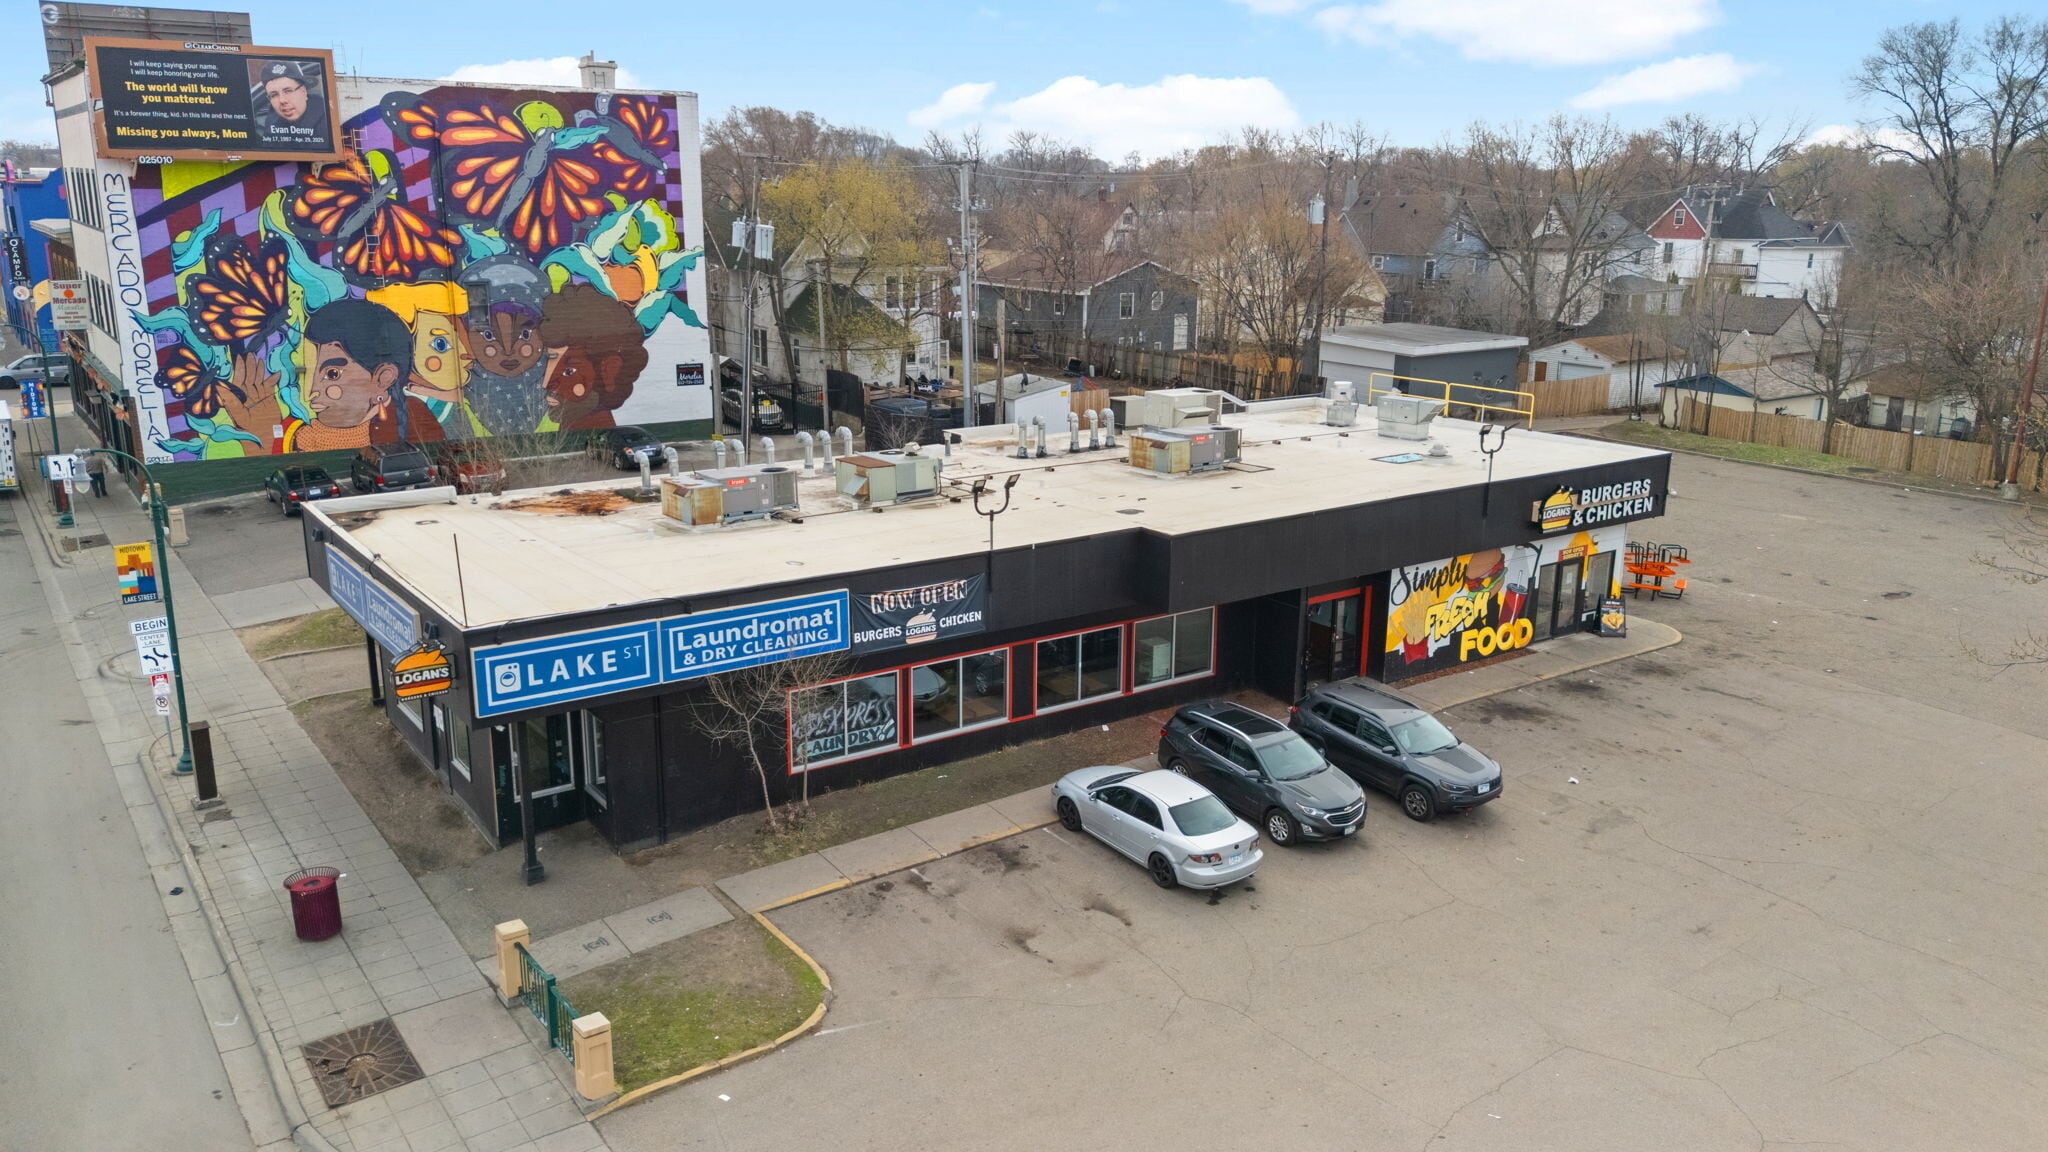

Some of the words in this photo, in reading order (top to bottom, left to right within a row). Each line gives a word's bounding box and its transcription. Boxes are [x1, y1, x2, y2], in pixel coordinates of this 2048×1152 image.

[146, 61, 162, 69] keep
[163, 62, 183, 70] saying
[147, 69, 162, 77] keep
[163, 70, 192, 78] honoring
[125, 81, 145, 91] The
[147, 83, 177, 93] world
[179, 83, 198, 93] will
[200, 84, 228, 94] know
[142, 95, 161, 104] you
[164, 94, 215, 104] mattered.
[116, 126, 159, 138] Missing
[160, 129, 179, 138] you
[181, 128, 220, 139] always,
[222, 129, 248, 138] Mom
[270, 125, 288, 134] Evan
[290, 125, 314, 136] Denny
[139, 155, 173, 164] 025010
[103, 173, 142, 307] MERCADO
[10, 239, 22, 277] OCAMPO
[132, 329, 164, 440] MORELIA
[1581, 478, 1651, 506] BURGERS
[1542, 505, 1571, 521] LOGAN'S
[1572, 510, 1583, 527] &
[1585, 496, 1653, 524] CHICKEN
[119, 544, 146, 553] MIDTOWN
[336, 570, 357, 603] LAKE
[1391, 557, 1469, 606] Simply
[123, 595, 138, 603] LAKE
[138, 592, 157, 602] STREET
[870, 589, 915, 614] NOW
[919, 579, 968, 604] OPEN
[367, 590, 412, 641] Laundromat
[939, 610, 982, 628] CHICKEN
[1424, 592, 1490, 641] FRESH
[135, 618, 167, 632] BEGIN
[677, 608, 834, 651] Laundromat
[905, 624, 937, 637] LOGAN'S
[140, 633, 165, 641] CENTER
[853, 626, 902, 643] BURGERS
[1460, 618, 1533, 662] FOOD
[683, 652, 697, 666] &
[702, 644, 738, 663] DRY
[742, 628, 829, 655] CLEANING
[527, 649, 618, 687] LAKE
[623, 645, 642, 660] ST
[395, 667, 450, 685] LOGAN'S
[823, 698, 895, 734] EXPRESS
